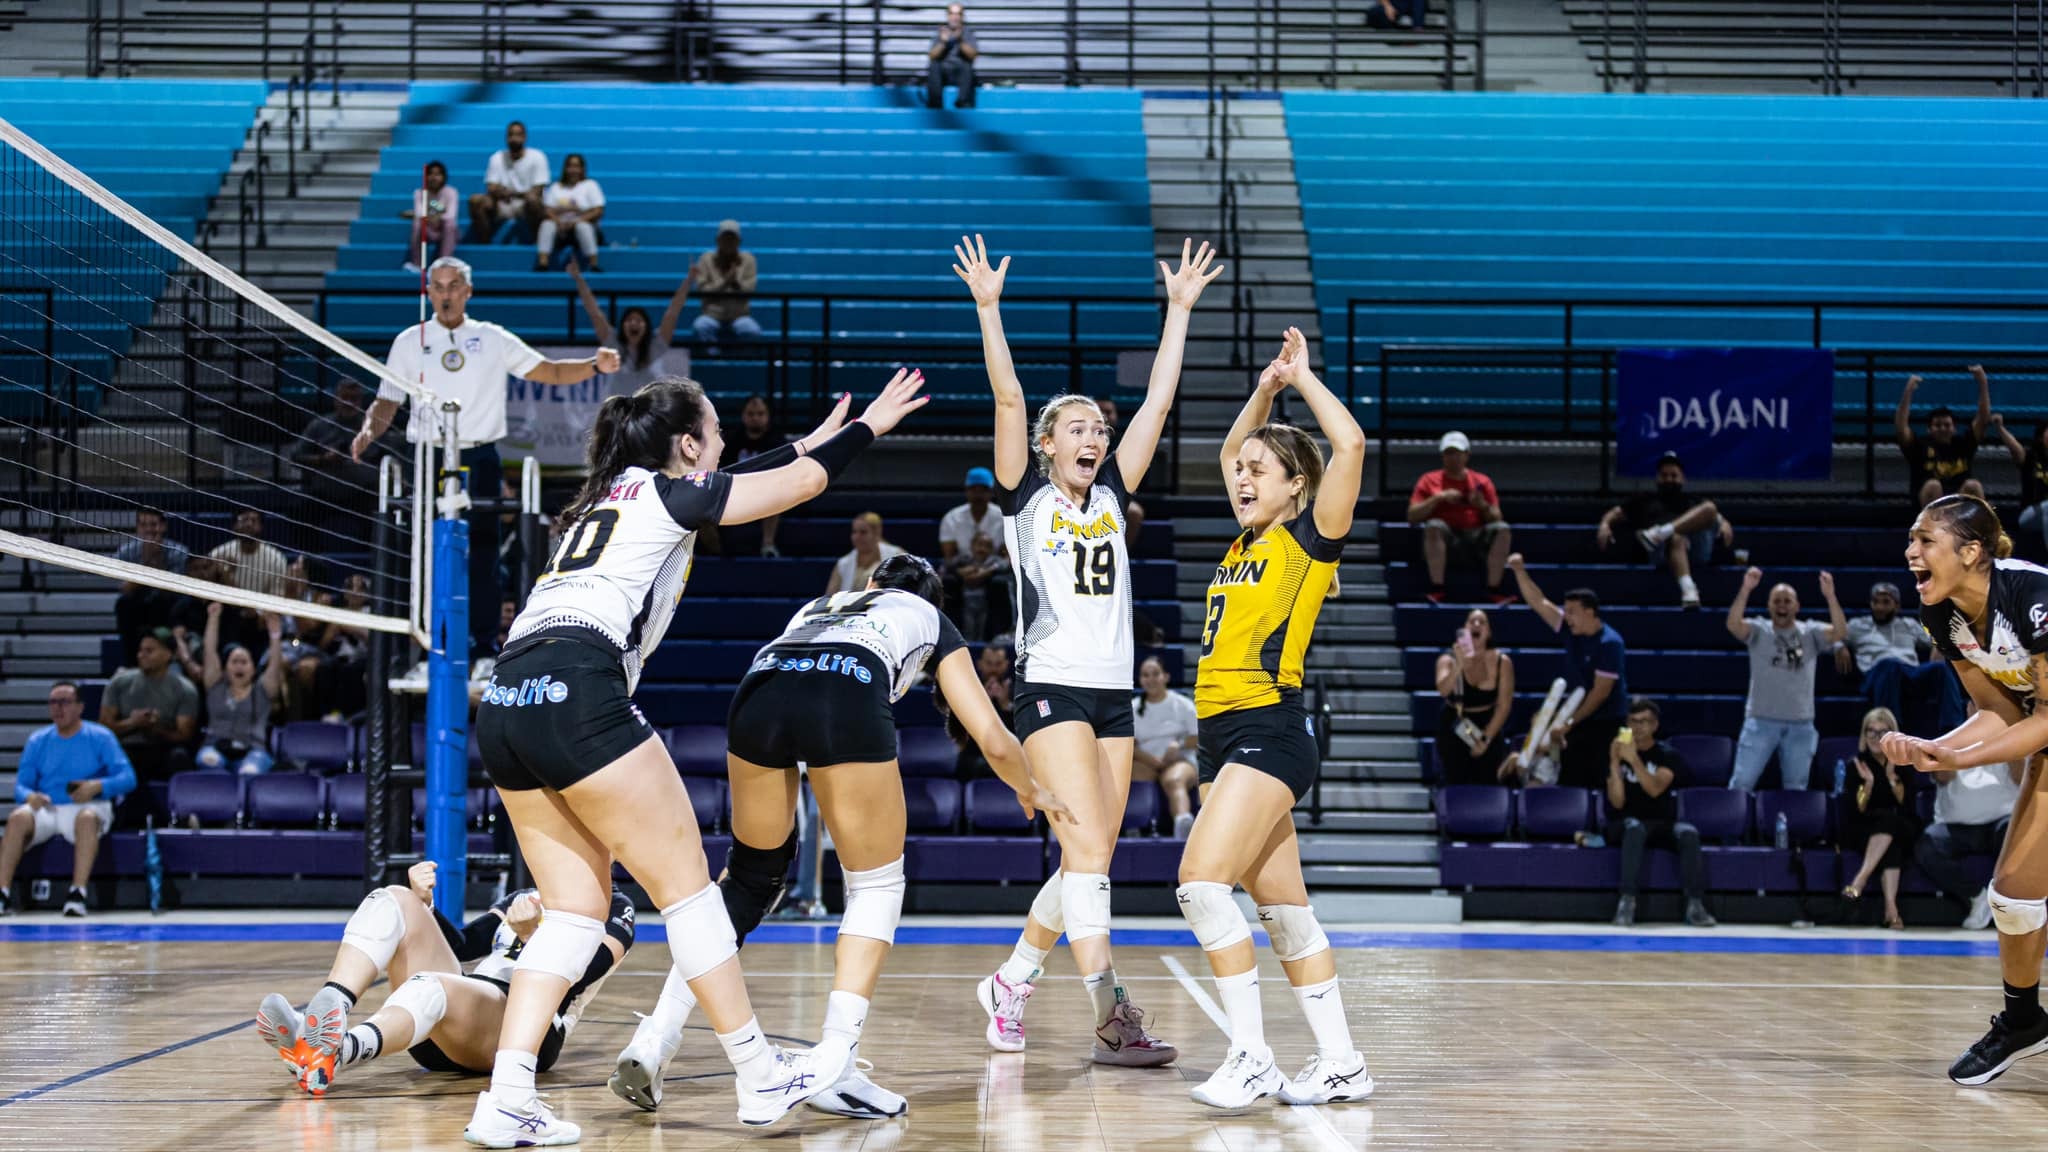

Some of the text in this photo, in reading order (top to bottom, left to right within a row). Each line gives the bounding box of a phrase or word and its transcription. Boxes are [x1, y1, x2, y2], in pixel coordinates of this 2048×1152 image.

[1658, 388, 1790, 438] DASANI
[1072, 540, 1117, 596] 19
[1212, 558, 1270, 588] NKIN
[481, 674, 568, 707] bsolife
